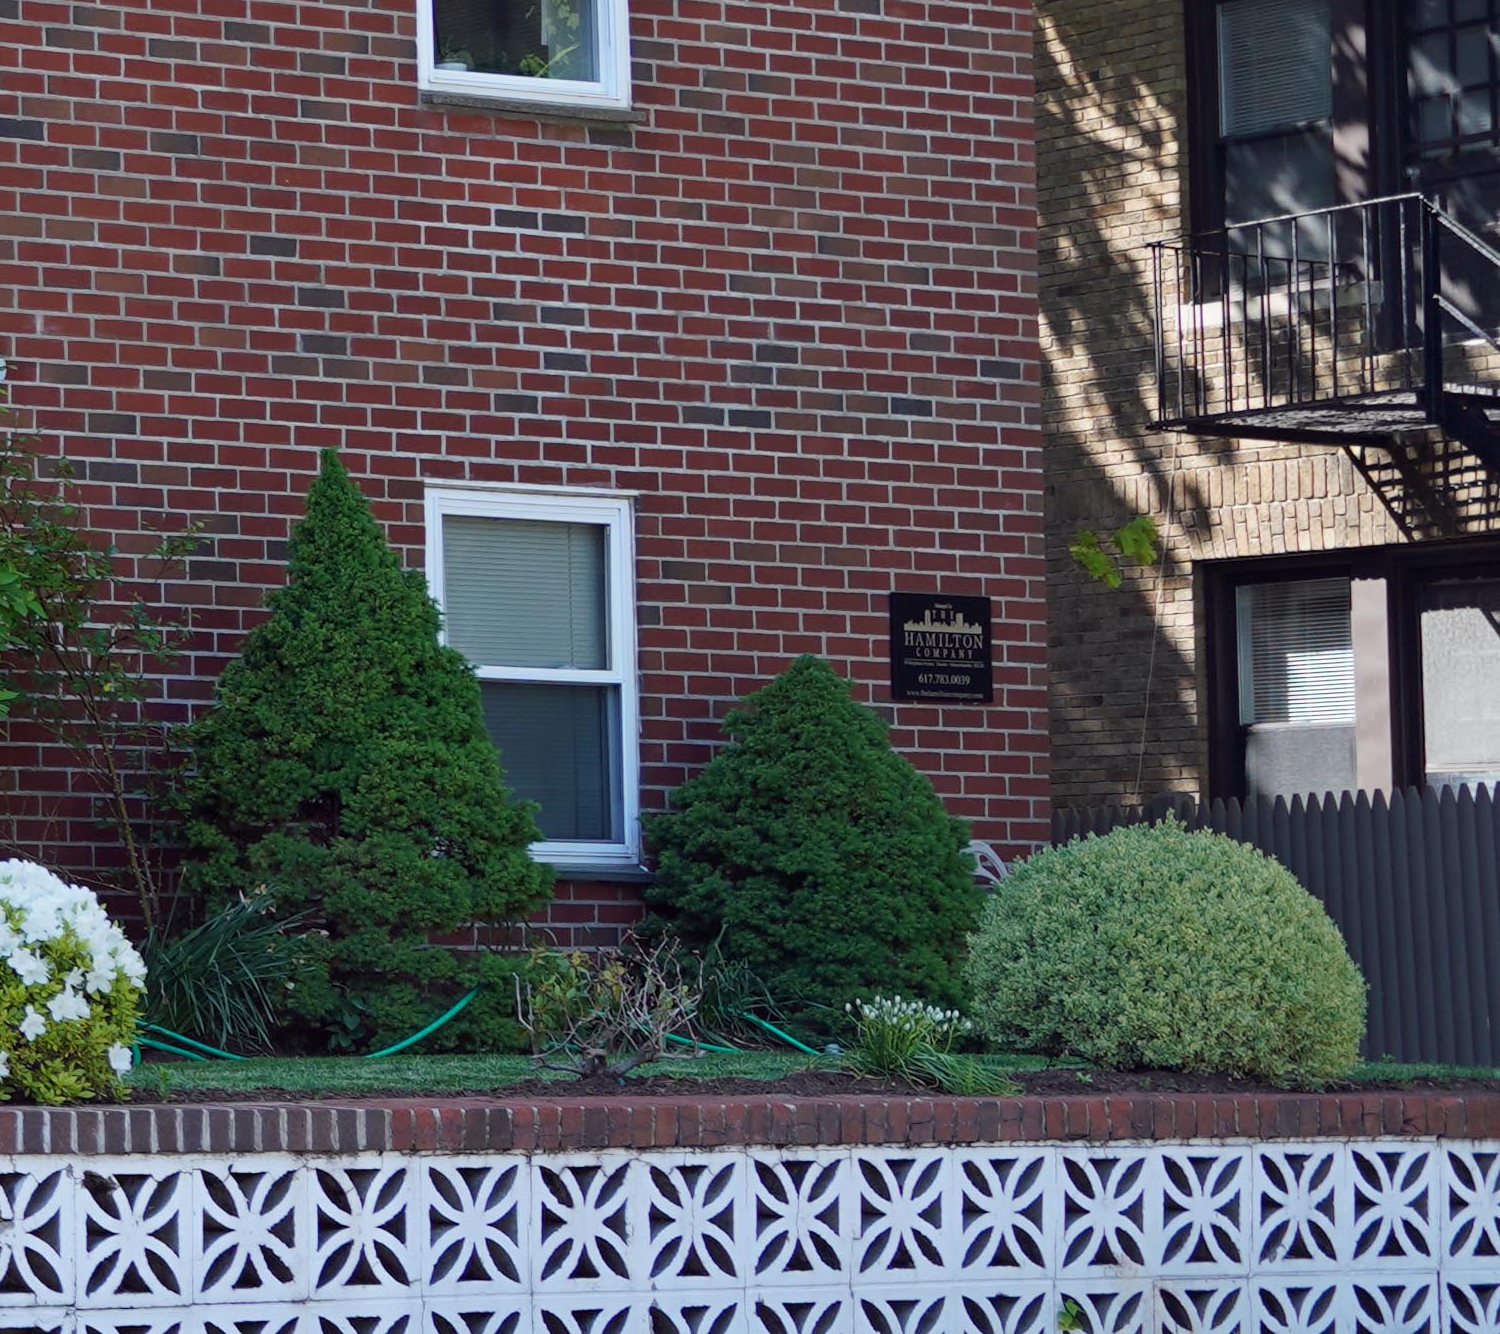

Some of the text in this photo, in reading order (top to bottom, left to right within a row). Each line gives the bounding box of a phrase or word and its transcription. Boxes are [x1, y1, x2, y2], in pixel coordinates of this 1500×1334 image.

[904, 632, 983, 648] HAMILTON
[915, 647, 973, 659] COMPANY
[918, 673, 970, 686] 617.783.0039
